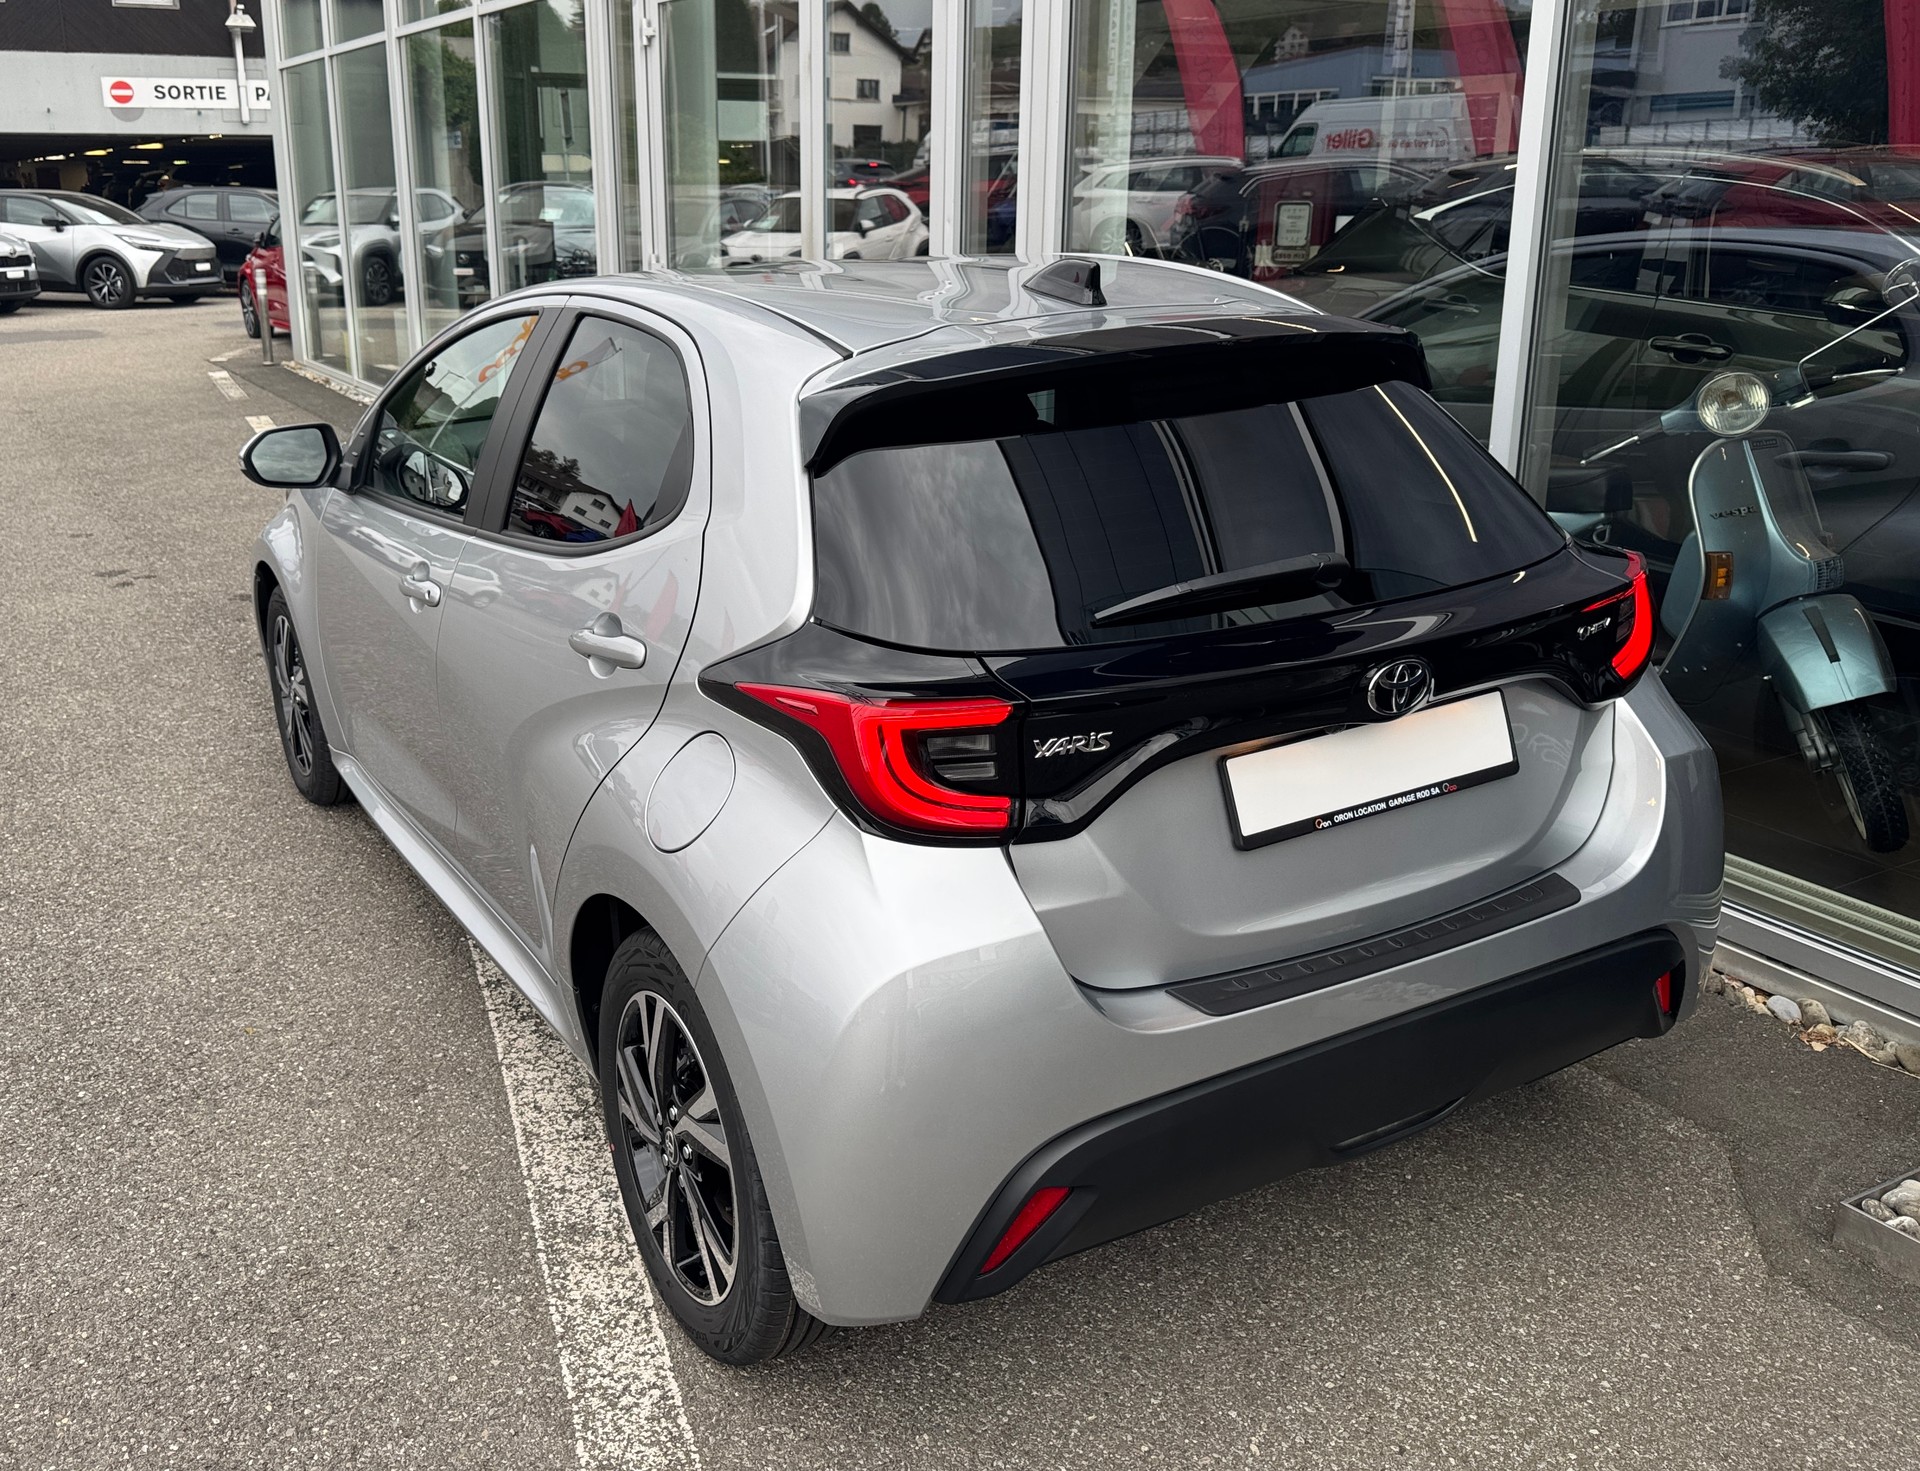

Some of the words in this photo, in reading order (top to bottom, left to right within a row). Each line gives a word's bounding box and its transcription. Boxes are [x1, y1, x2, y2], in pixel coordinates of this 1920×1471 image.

[153, 85, 227, 100] SORTIE
[1333, 811, 1354, 823] ORON
[1353, 802, 1387, 818] LOCATION
[1388, 793, 1416, 807] GARAGE
[1415, 789, 1431, 800] ROD
[1430, 786, 1441, 796] SA
